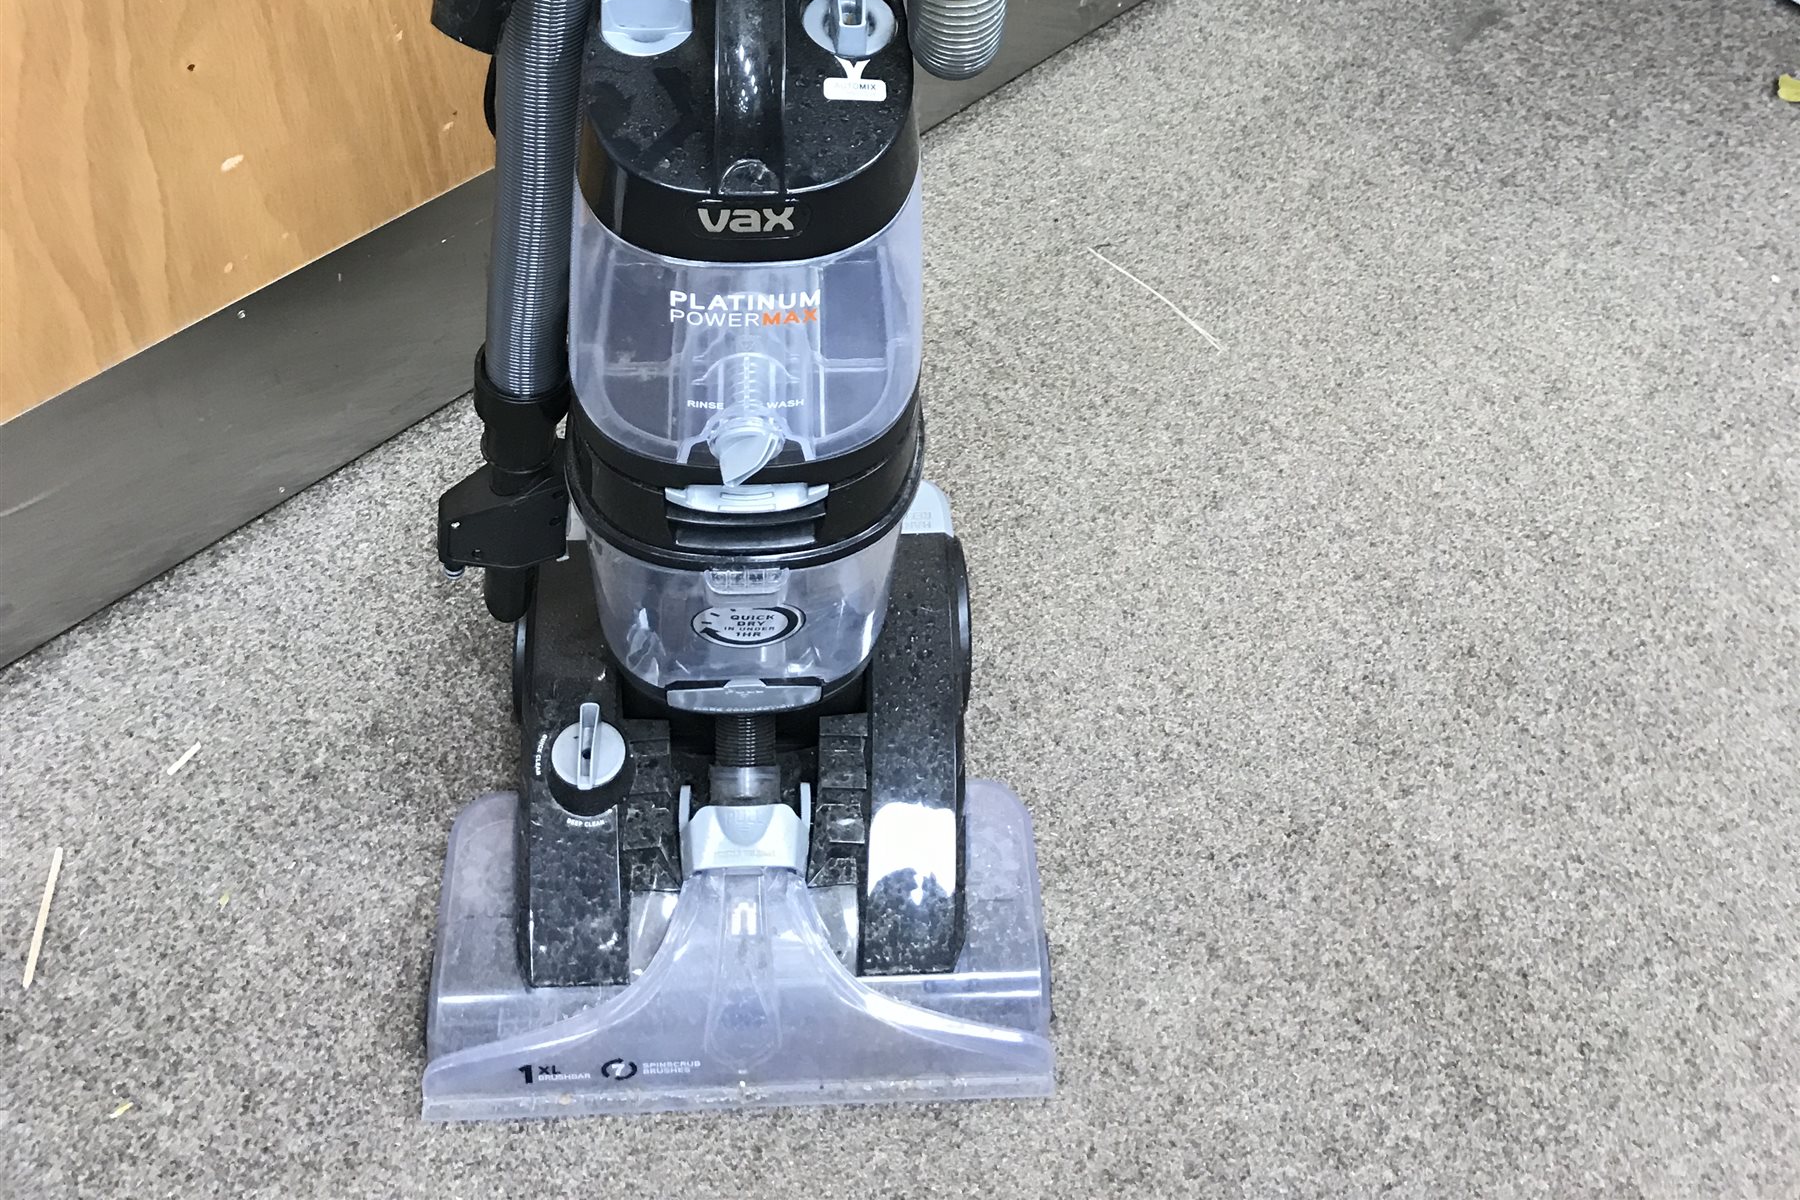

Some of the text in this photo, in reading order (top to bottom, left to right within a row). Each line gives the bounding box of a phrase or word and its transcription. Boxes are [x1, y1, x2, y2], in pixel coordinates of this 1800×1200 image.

[669, 289, 821, 311] PLATINUM
[669, 308, 818, 327] POWERMAX
[687, 399, 724, 410] RINSE
[766, 399, 805, 409] WASH
[566, 817, 606, 828] DEEP CLEAN
[518, 1064, 561, 1084] 1 XL
[611, 1063, 625, 1077] 7
[538, 1073, 591, 1081] BRUSHBAR
